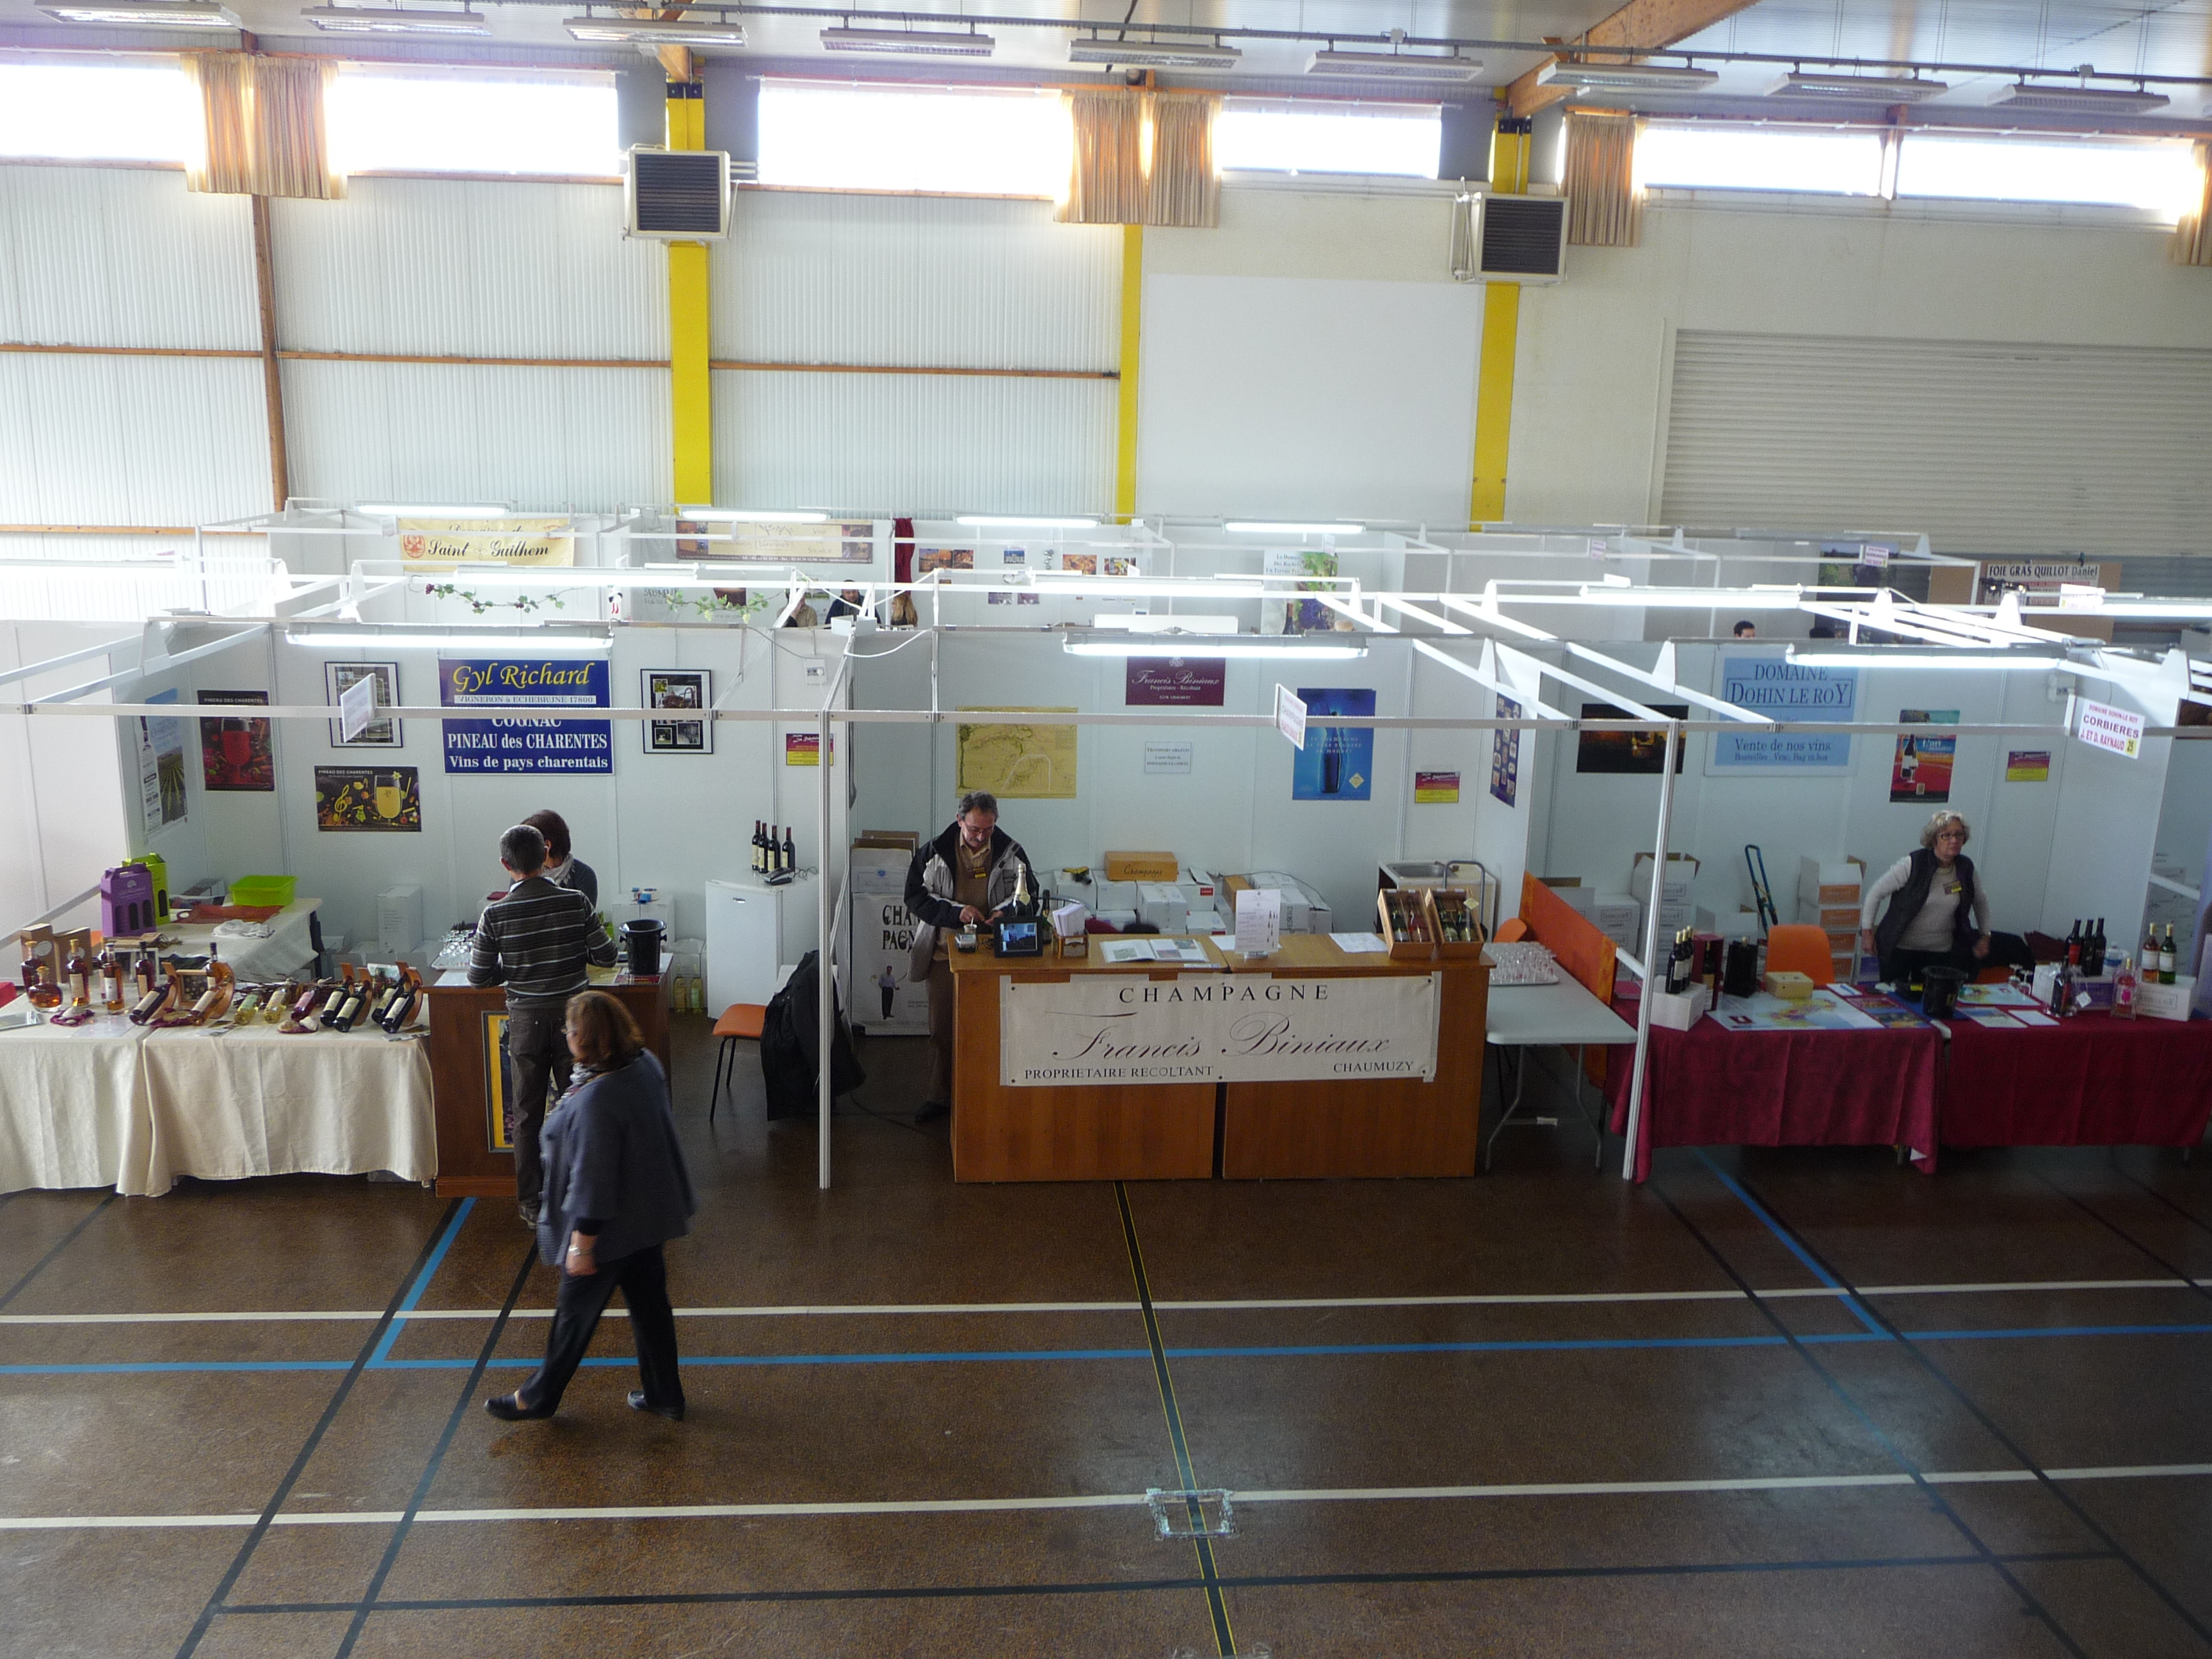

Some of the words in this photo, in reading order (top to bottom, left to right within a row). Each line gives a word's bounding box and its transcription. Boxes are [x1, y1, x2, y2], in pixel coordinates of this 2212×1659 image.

[428, 540, 470, 557] Saint
[490, 540, 549, 557] Guilhem
[1989, 566, 2007, 576] FOIE
[2010, 566, 2032, 576] GRAS
[2034, 566, 2069, 578] QUILLOT
[2071, 566, 2098, 576] Daniel
[453, 662, 498, 692] Gyl
[500, 662, 595, 689] Richard
[1132, 669, 1171, 684] Francis
[1755, 664, 1828, 681] DOMAINE
[1731, 683, 1785, 704] DOHIN
[2083, 715, 2139, 739] CORBIERES
[448, 733, 497, 748] PINEAU
[501, 734, 522, 748] des
[526, 733, 607, 749] CHARENTES
[1735, 738, 1767, 751] Vente
[1770, 739, 1783, 751] de
[1786, 741, 1804, 751] nos
[1808, 738, 1831, 751] vins
[2087, 730, 2094, 741] ET
[2100, 734, 2125, 751] RAYNAUD
[449, 756, 479, 767] Vins
[483, 756, 499, 767] de
[504, 758, 533, 771] pays
[538, 756, 608, 767] charentais
[1119, 984, 1328, 1003] CHAMPAGNE
[1045, 1011, 1201, 1061] Francis
[1221, 1011, 1390, 1057] Biniaux
[1025, 1068, 1126, 1079] PROPRIETAIRE
[1132, 1066, 1214, 1077] RECOLTANT
[1333, 1061, 1414, 1073] CHAUMUZY
